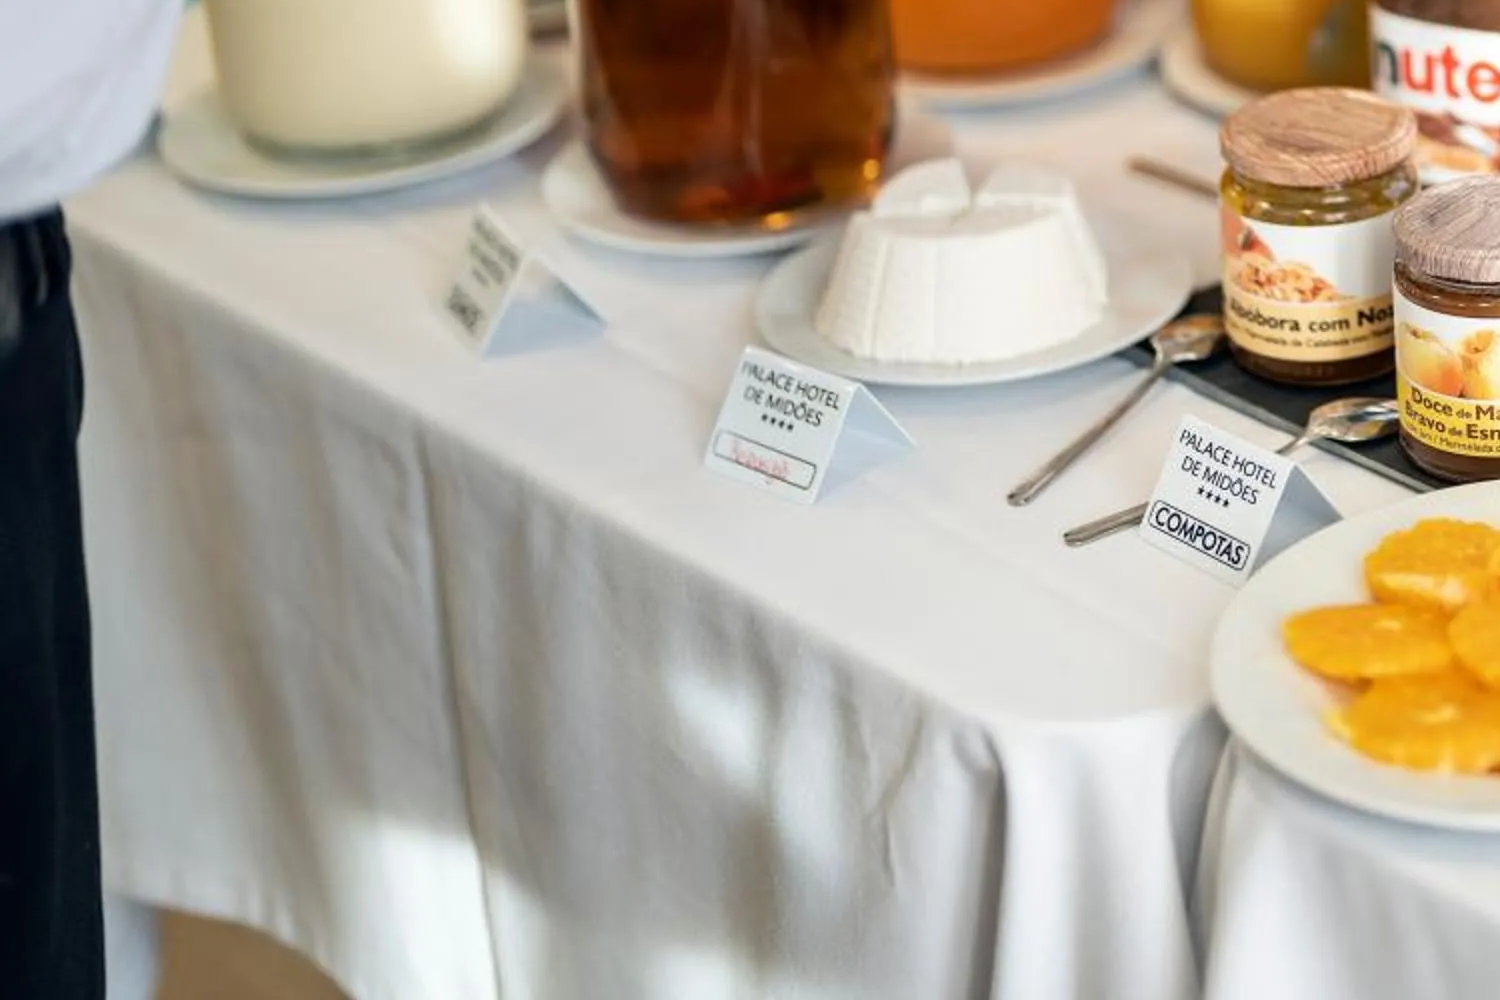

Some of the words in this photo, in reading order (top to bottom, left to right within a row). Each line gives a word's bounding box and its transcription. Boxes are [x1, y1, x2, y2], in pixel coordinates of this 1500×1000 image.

[1308, 317, 1350, 333] com
[741, 361, 794, 393] PALACE
[793, 380, 841, 411] HOTEL
[743, 386, 764, 406] DE
[765, 393, 824, 427] MIDÕES
[1411, 386, 1452, 417] Doce
[1456, 408, 1473, 420] de
[1404, 400, 1446, 433] Bravo
[1179, 429, 1233, 466] PALACE
[1232, 455, 1278, 489] HOTEL
[1181, 455, 1201, 477] DE
[1202, 467, 1260, 505] MIDÕES
[1155, 507, 1245, 565] COMPOTAS
